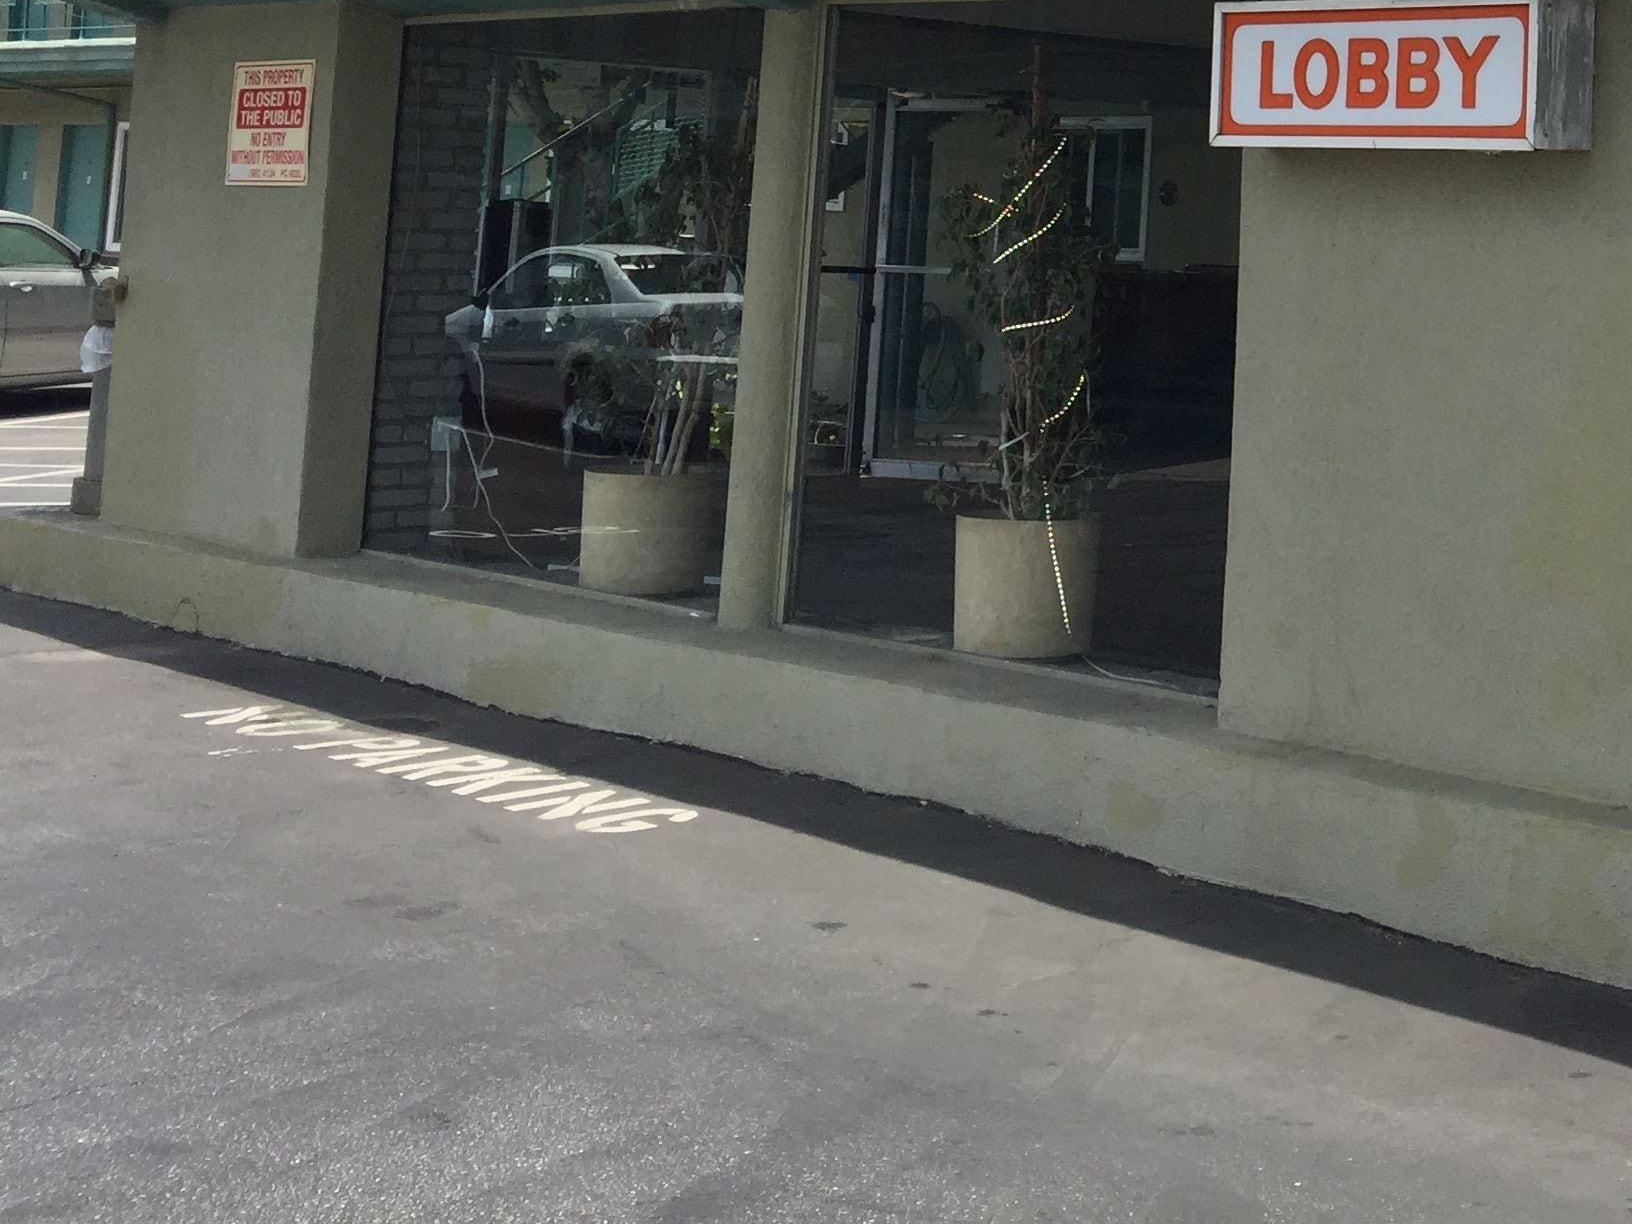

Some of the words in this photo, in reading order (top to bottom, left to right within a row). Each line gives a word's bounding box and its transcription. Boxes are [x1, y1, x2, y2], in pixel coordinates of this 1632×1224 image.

[244, 70, 261, 85] THIS
[262, 68, 305, 85] PROPERTY
[1259, 35, 1500, 110] LOBBY
[242, 91, 285, 107] CLOSED
[287, 90, 302, 106] TO
[240, 110, 261, 126] THE
[262, 109, 302, 126] PUBLIC
[249, 132, 261, 147] NO
[262, 131, 288, 147] ENTRY
[231, 150, 262, 165] WITHOUT
[262, 150, 305, 165] PERMISSION
[180, 704, 341, 737] NO
[293, 737, 699, 834] PARKING
